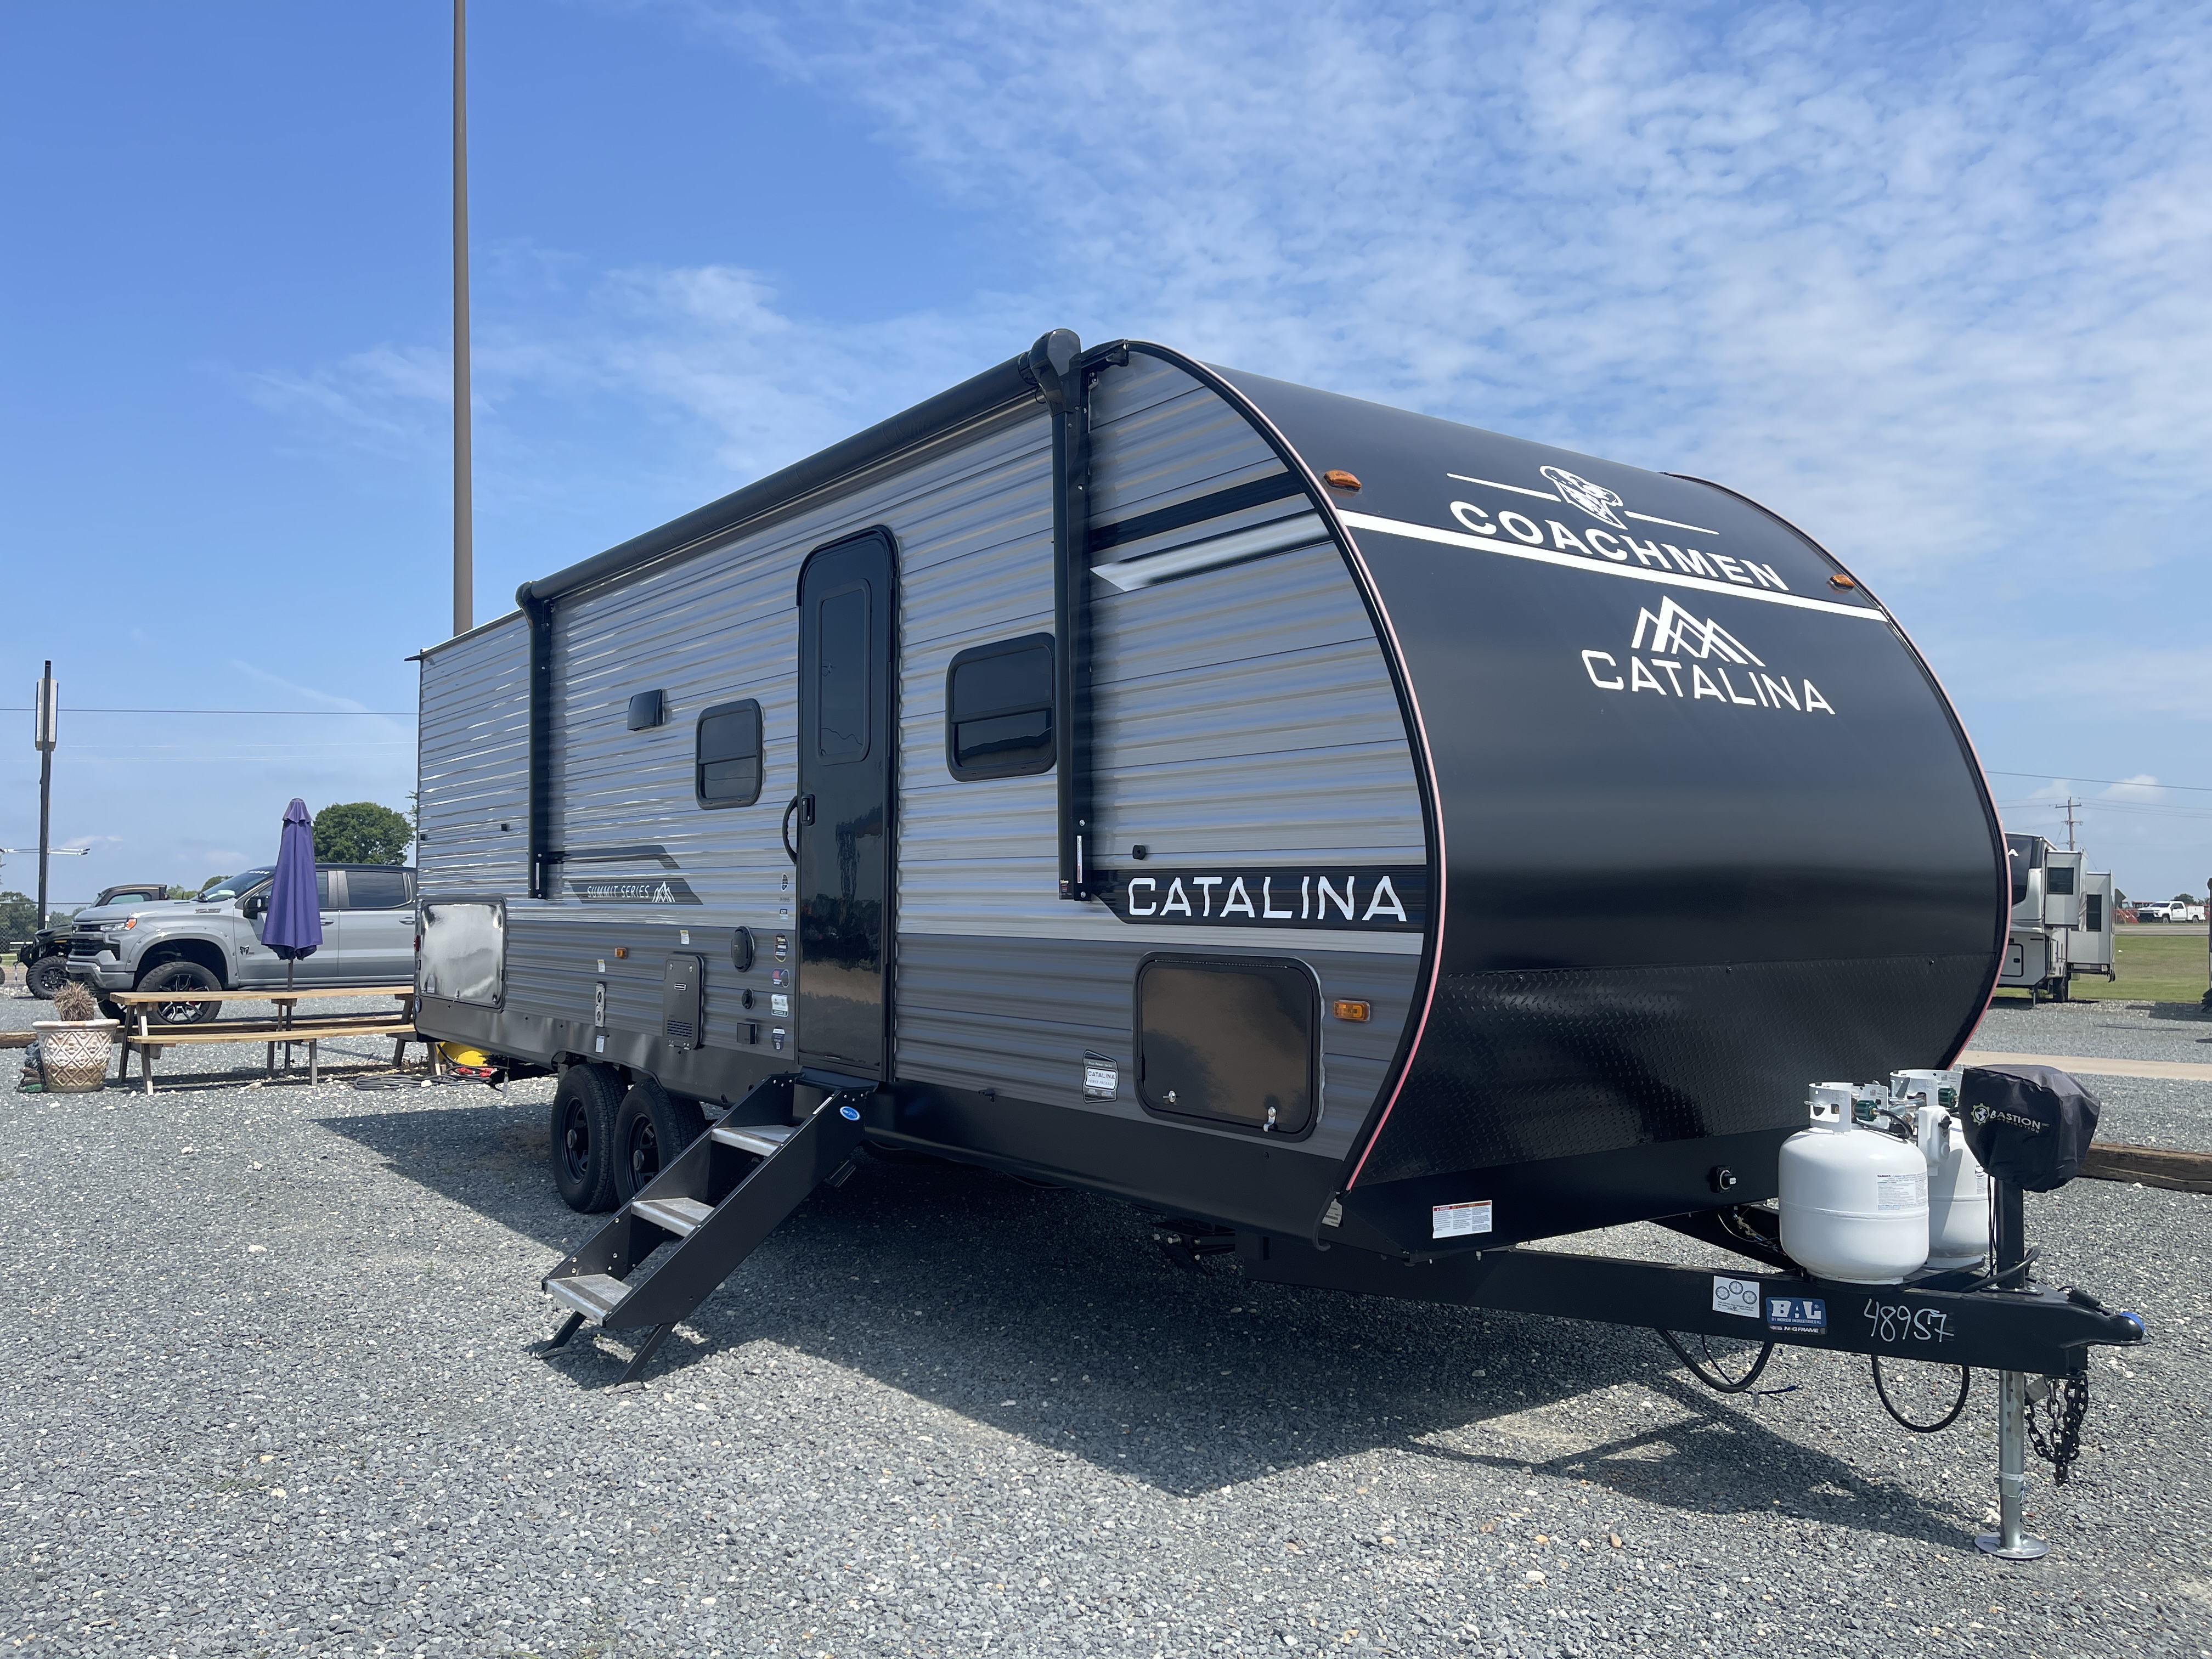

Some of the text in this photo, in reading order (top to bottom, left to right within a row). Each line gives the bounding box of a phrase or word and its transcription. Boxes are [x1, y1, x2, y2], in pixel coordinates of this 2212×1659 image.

[1450, 501, 1790, 591] COACHMEN
[1581, 650, 1836, 715] CATALINA
[587, 885, 650, 898] SUMMIT SERIES
[1128, 876, 1407, 922] CATALINA
[1088, 1071, 1115, 1079] CATALINA
[1990, 1110, 2041, 1130] BASTION
[1771, 1300, 1821, 1319] BAL
[1864, 1297, 1955, 1343] 48957
